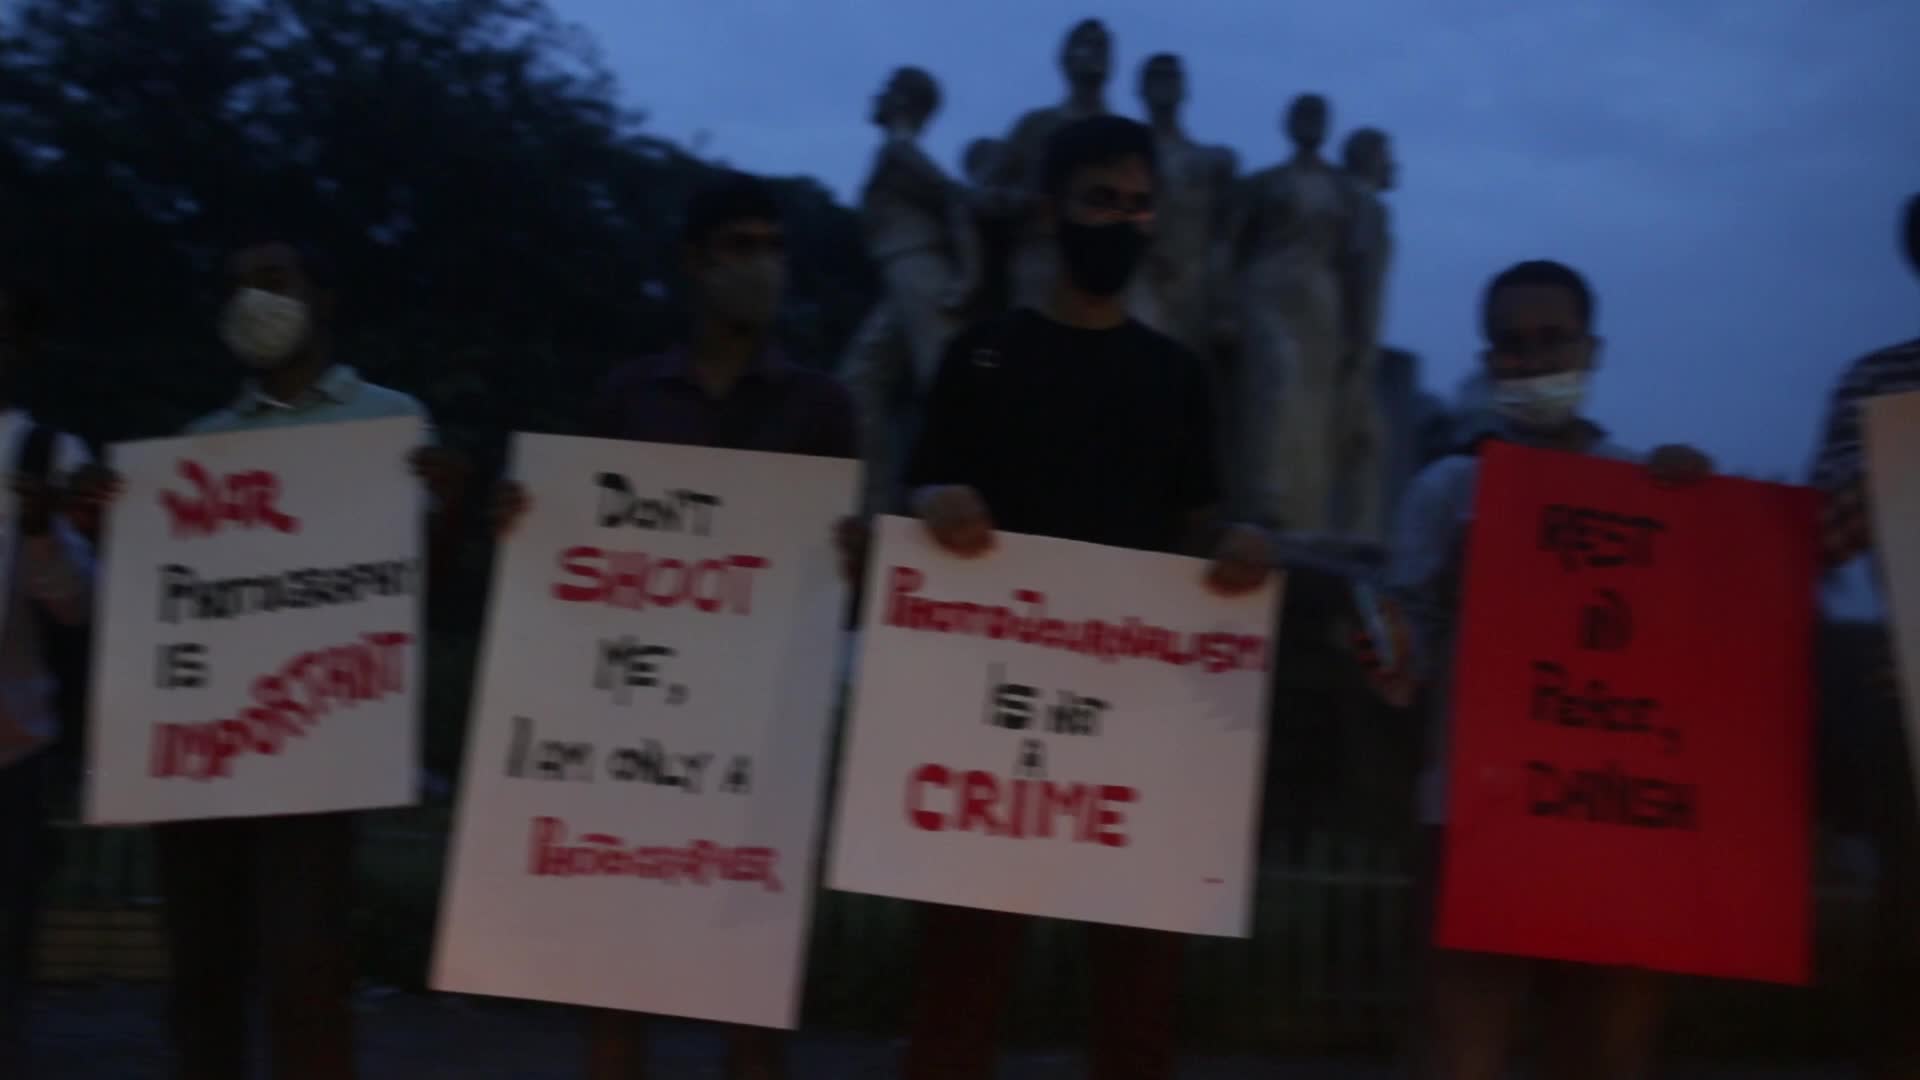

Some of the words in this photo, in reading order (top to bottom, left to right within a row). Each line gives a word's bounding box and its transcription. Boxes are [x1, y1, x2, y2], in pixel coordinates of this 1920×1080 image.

[553, 546, 769, 615] SHOOT
[156, 642, 208, 690] IS
[506, 715, 533, 778] I
[906, 763, 1140, 848] CRIME
